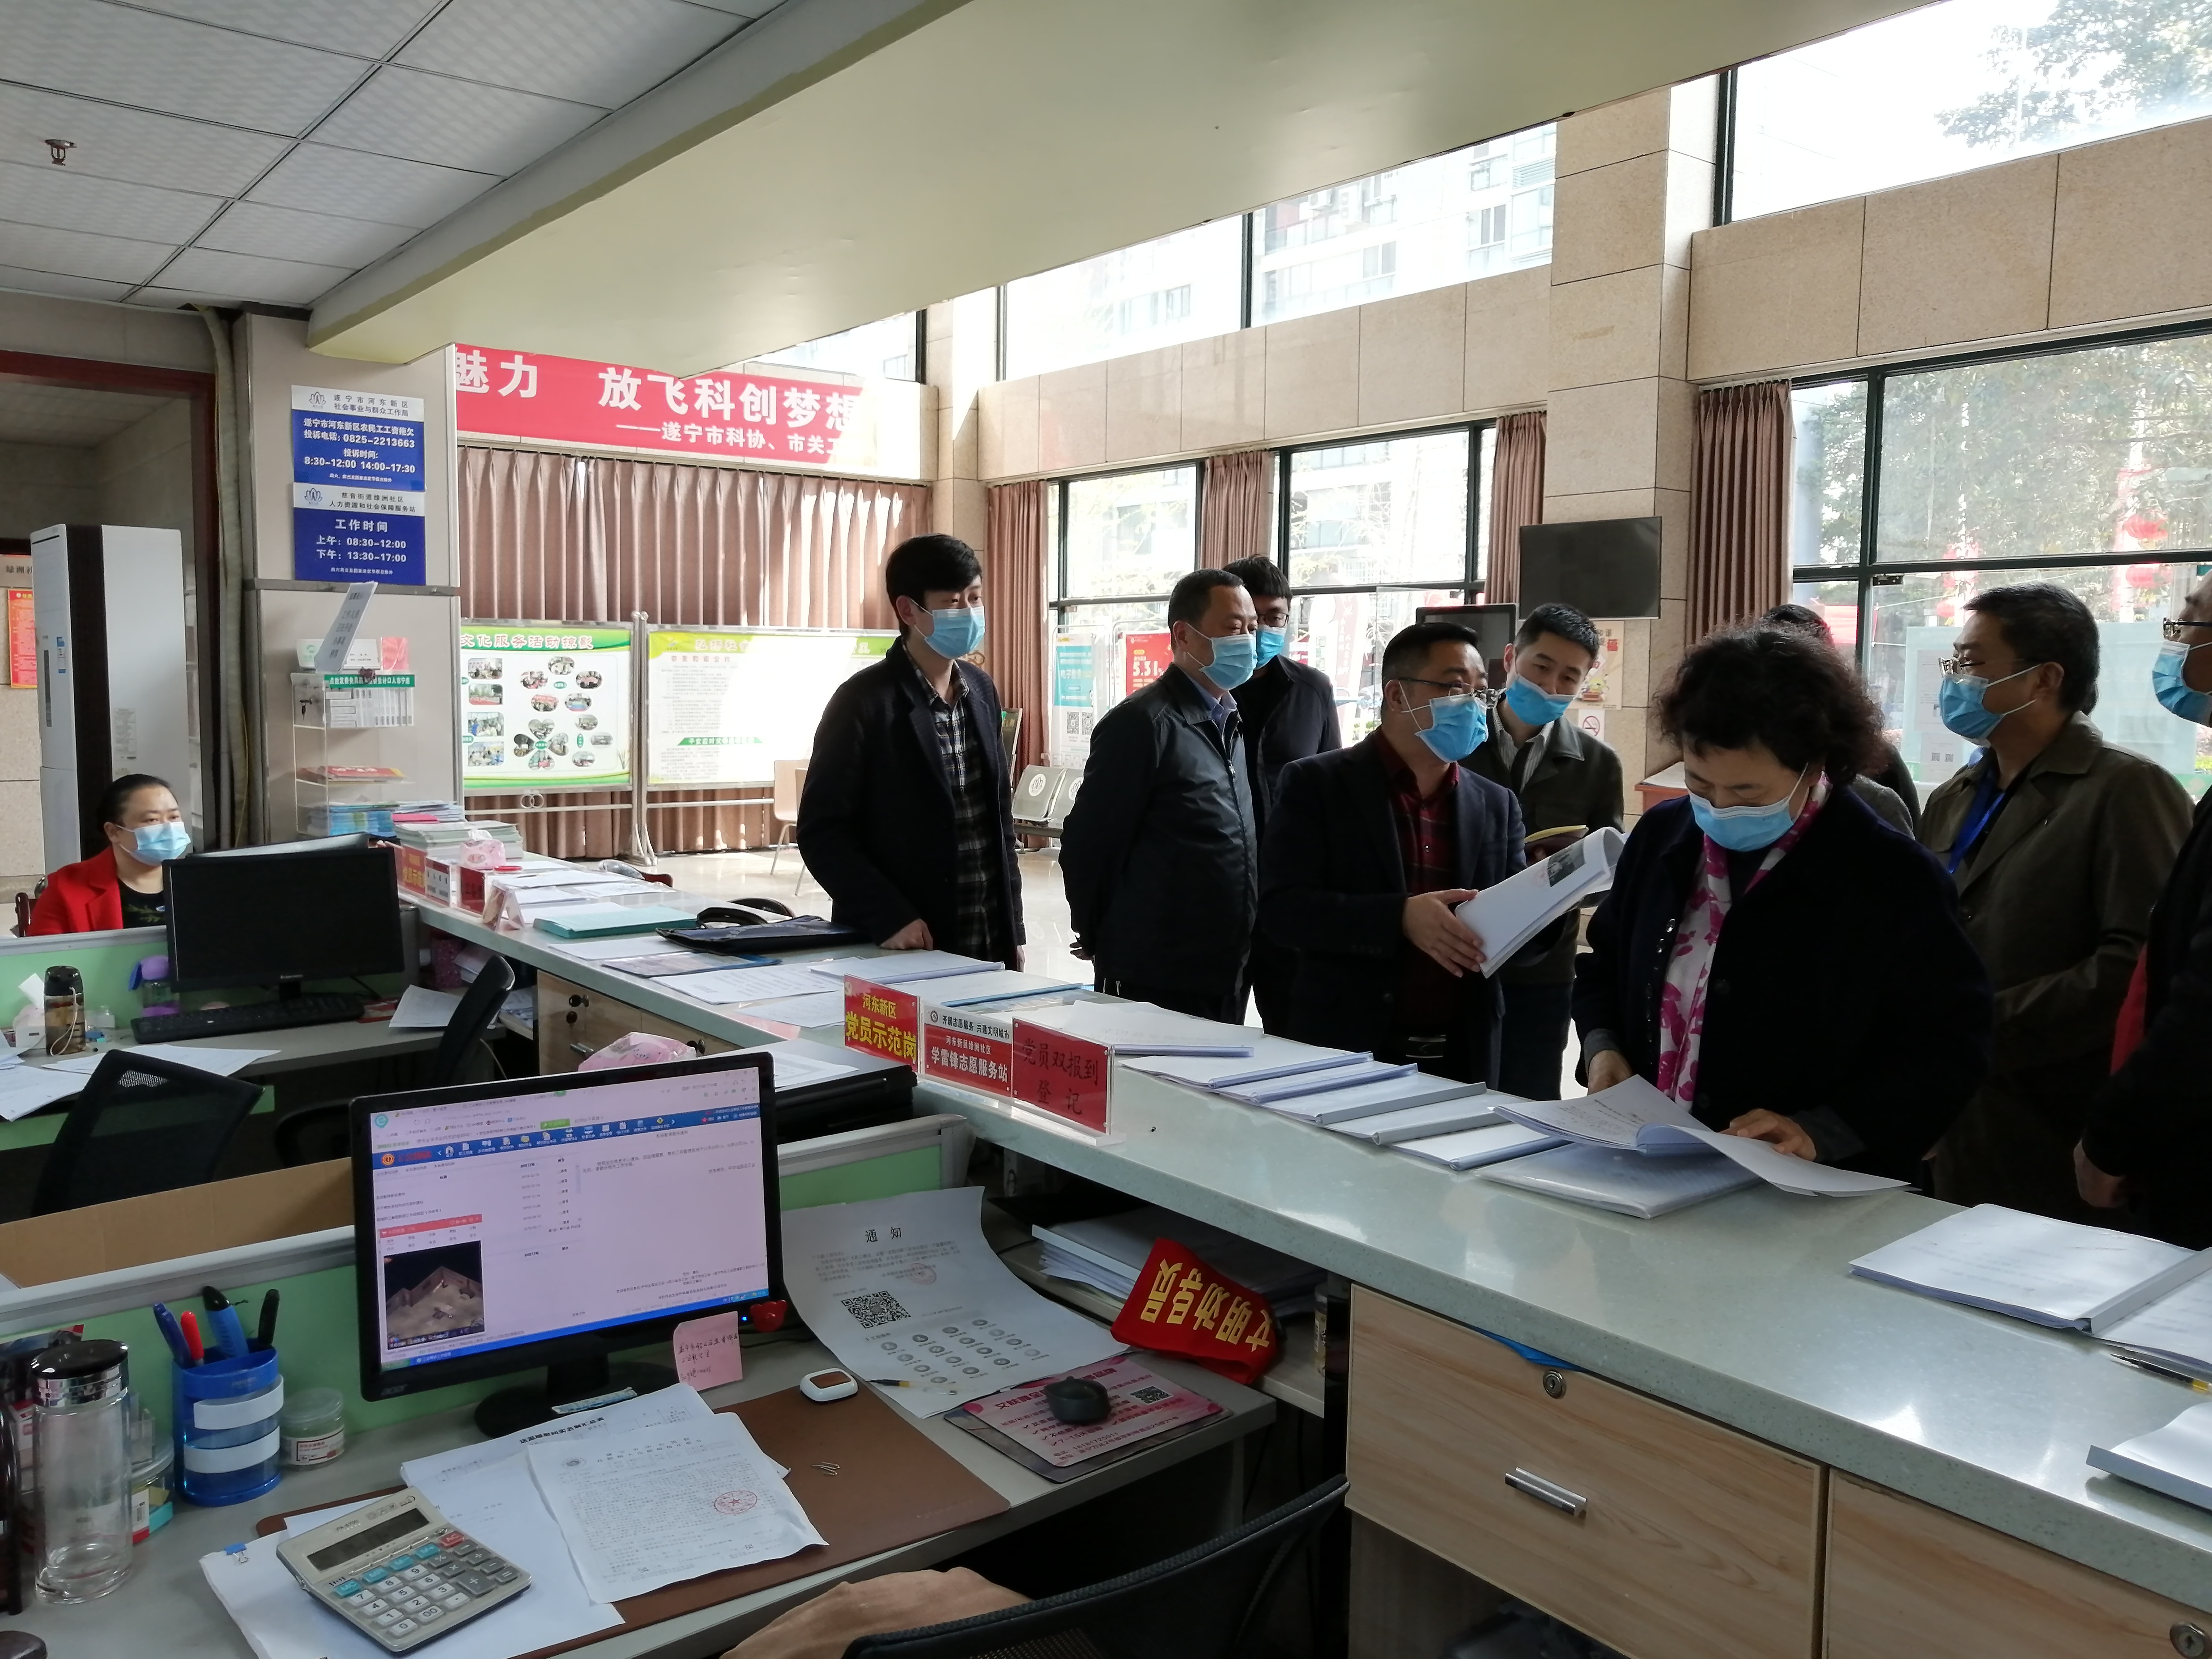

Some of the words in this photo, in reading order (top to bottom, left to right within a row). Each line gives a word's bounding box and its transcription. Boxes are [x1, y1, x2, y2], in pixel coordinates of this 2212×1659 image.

[333, 394, 409, 408] 遂宁市河东新区
[455, 348, 538, 399] 魅力
[598, 366, 855, 431] 放飞科创梦想
[330, 500, 416, 513] 人力资源和社会保障服务站
[335, 519, 388, 533] 工作时间
[862, 992, 897, 1019] 河东新区
[846, 1011, 917, 1064] 党员示范岗
[942, 1015, 974, 1031] 开展志愿服务
[976, 1023, 1009, 1039] 共建文明城市
[931, 1046, 1008, 1083] 学雷锋志愿服务站
[1022, 1039, 1099, 1086] 党员双报到
[1037, 1080, 1083, 1115] 登记
[864, 1226, 903, 1243] 通知
[1140, 1258, 1273, 1353] 文明劝导员
[445, 1533, 458, 1542] AC
[385, 1579, 394, 1587] 8
[398, 1622, 408, 1630] 0
